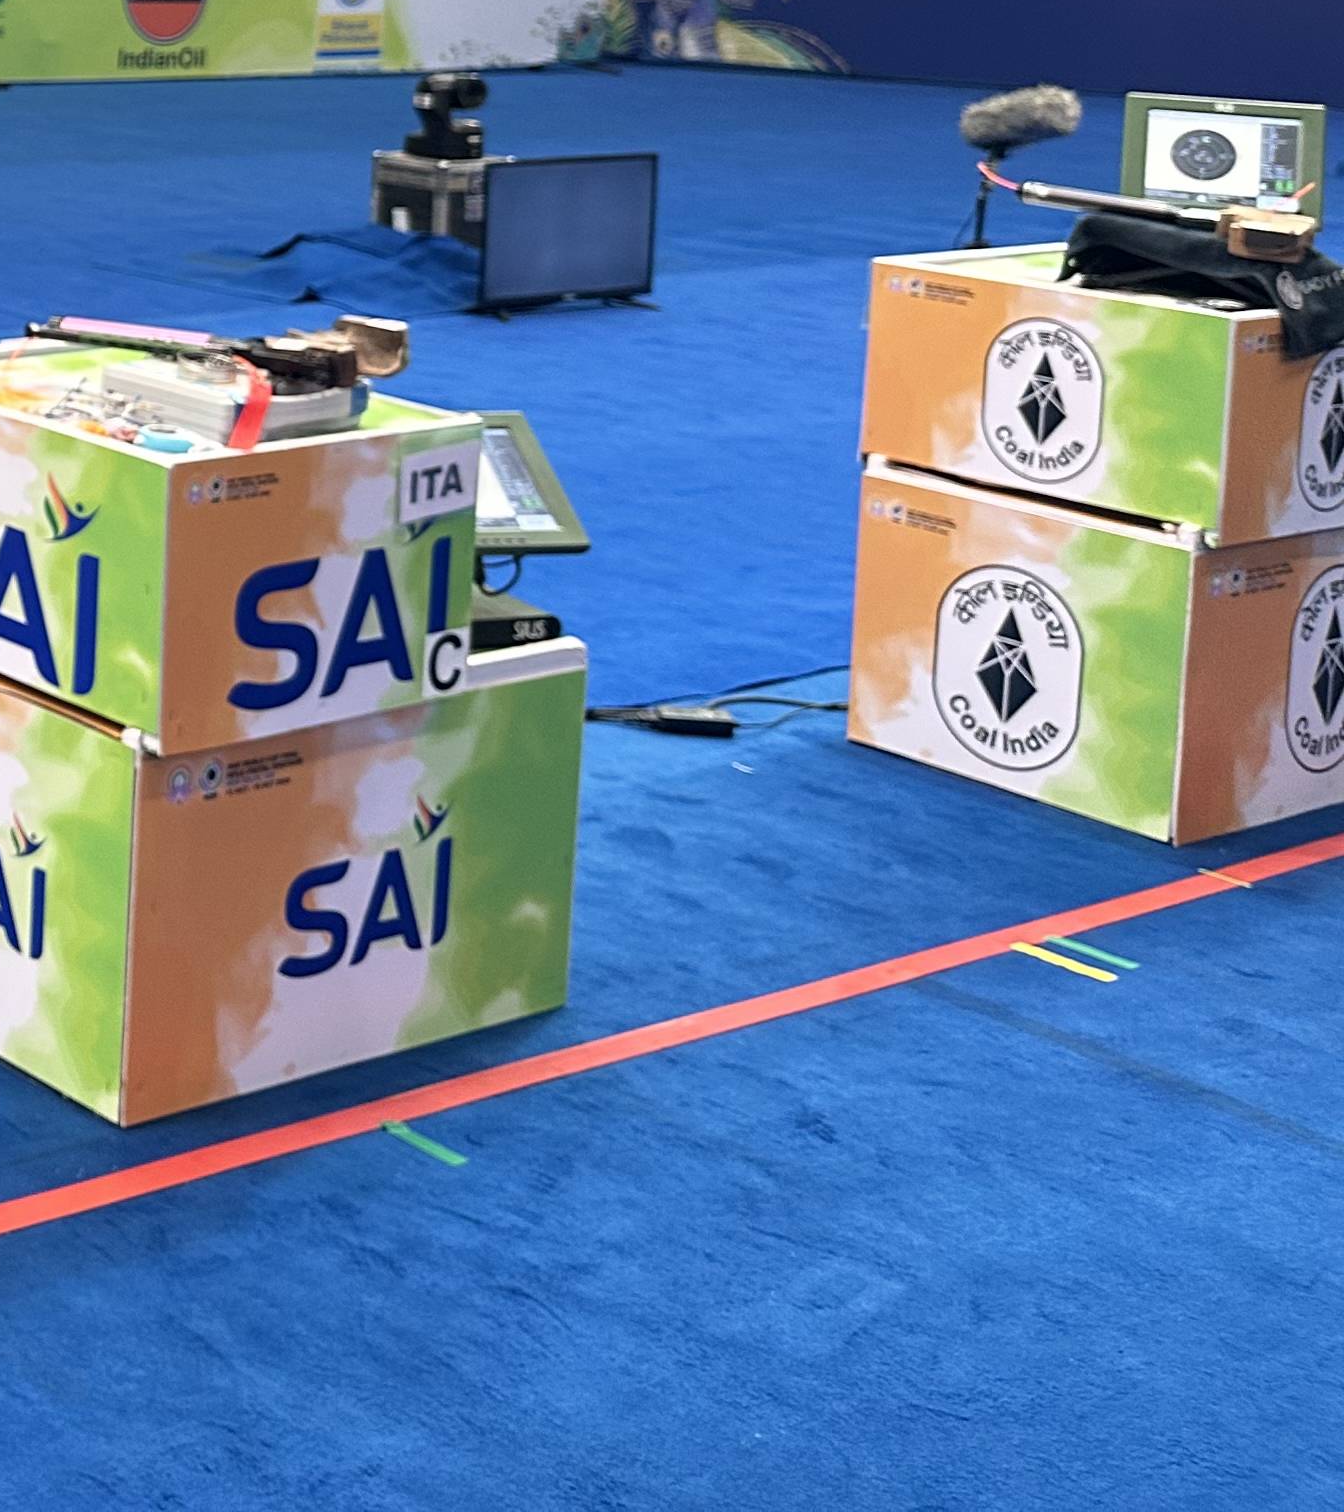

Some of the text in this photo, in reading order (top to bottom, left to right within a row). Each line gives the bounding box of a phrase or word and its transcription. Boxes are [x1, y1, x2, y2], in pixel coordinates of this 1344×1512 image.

[117, 46, 206, 70] IndianOil
[995, 425, 1085, 470] Coal India
[409, 463, 463, 504] ITA
[226, 535, 452, 710] SAI
[953, 579, 998, 625] कोल
[512, 619, 548, 641] SIUS
[428, 633, 462, 692] C
[949, 694, 1060, 755] Coal India
[1294, 715, 1322, 756] Coal
[278, 835, 453, 978] SAI
